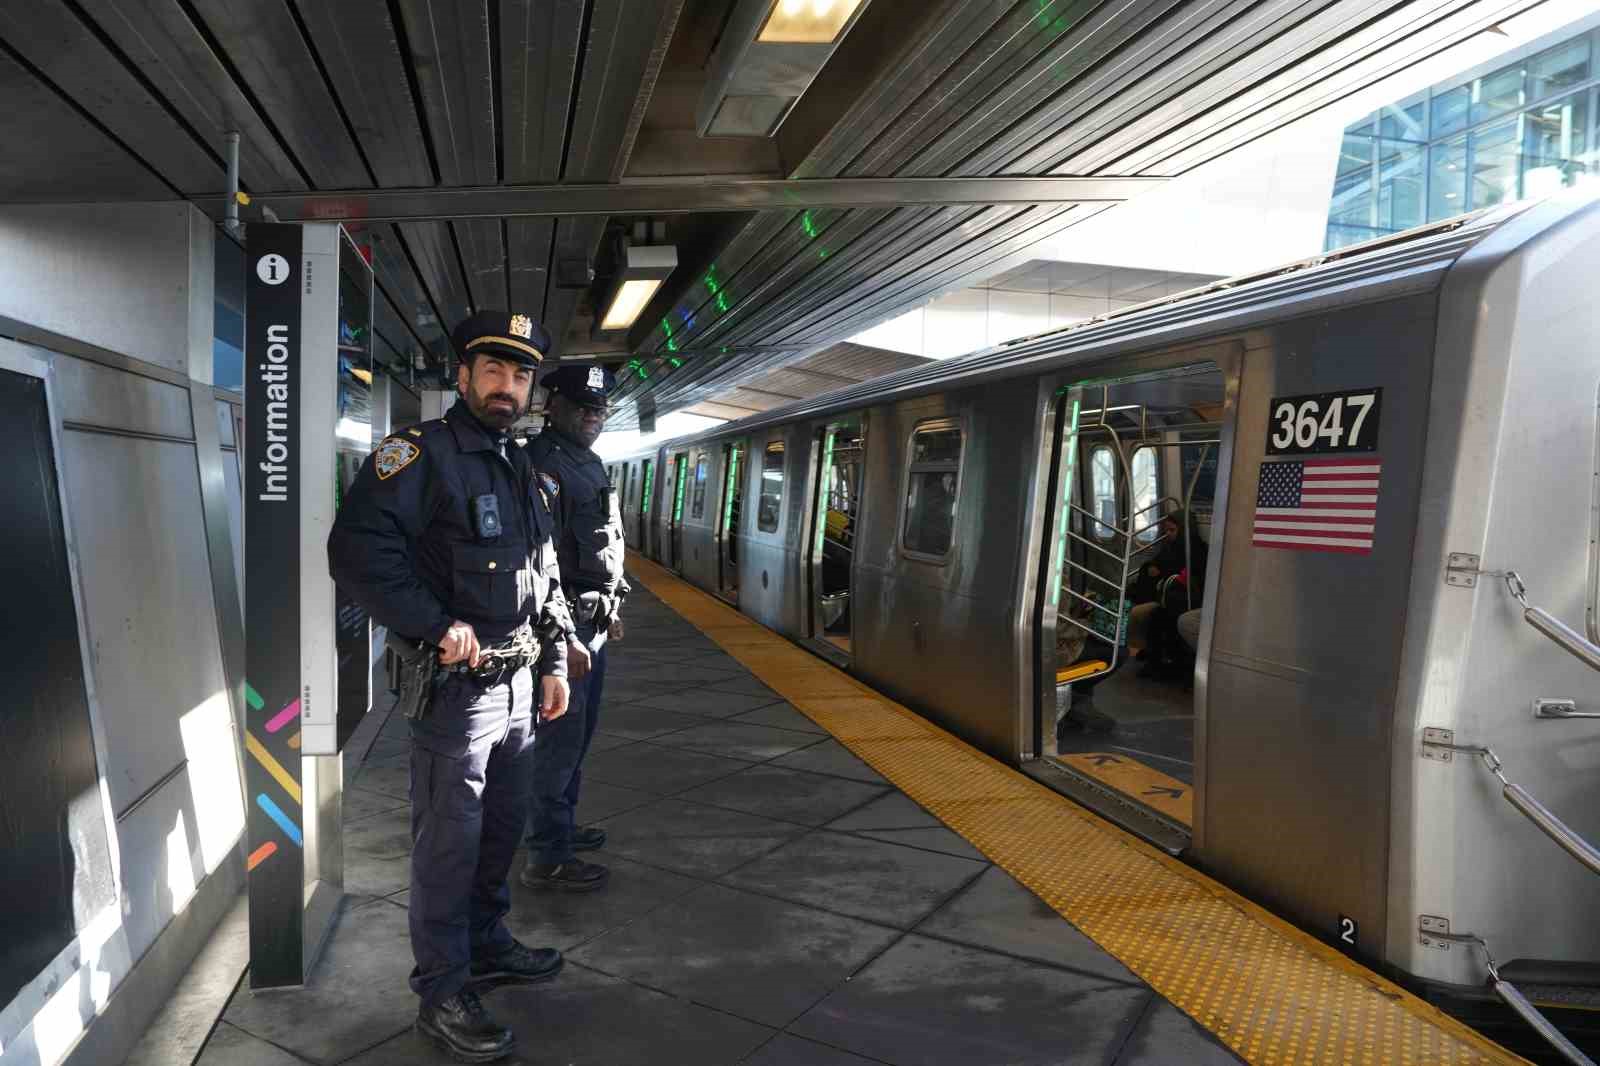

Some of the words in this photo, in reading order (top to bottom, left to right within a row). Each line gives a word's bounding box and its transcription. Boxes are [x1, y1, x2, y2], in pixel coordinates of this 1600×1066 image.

[259, 324, 289, 501] Information
[1272, 394, 1375, 449] 3647
[1341, 918, 1354, 944] 2
